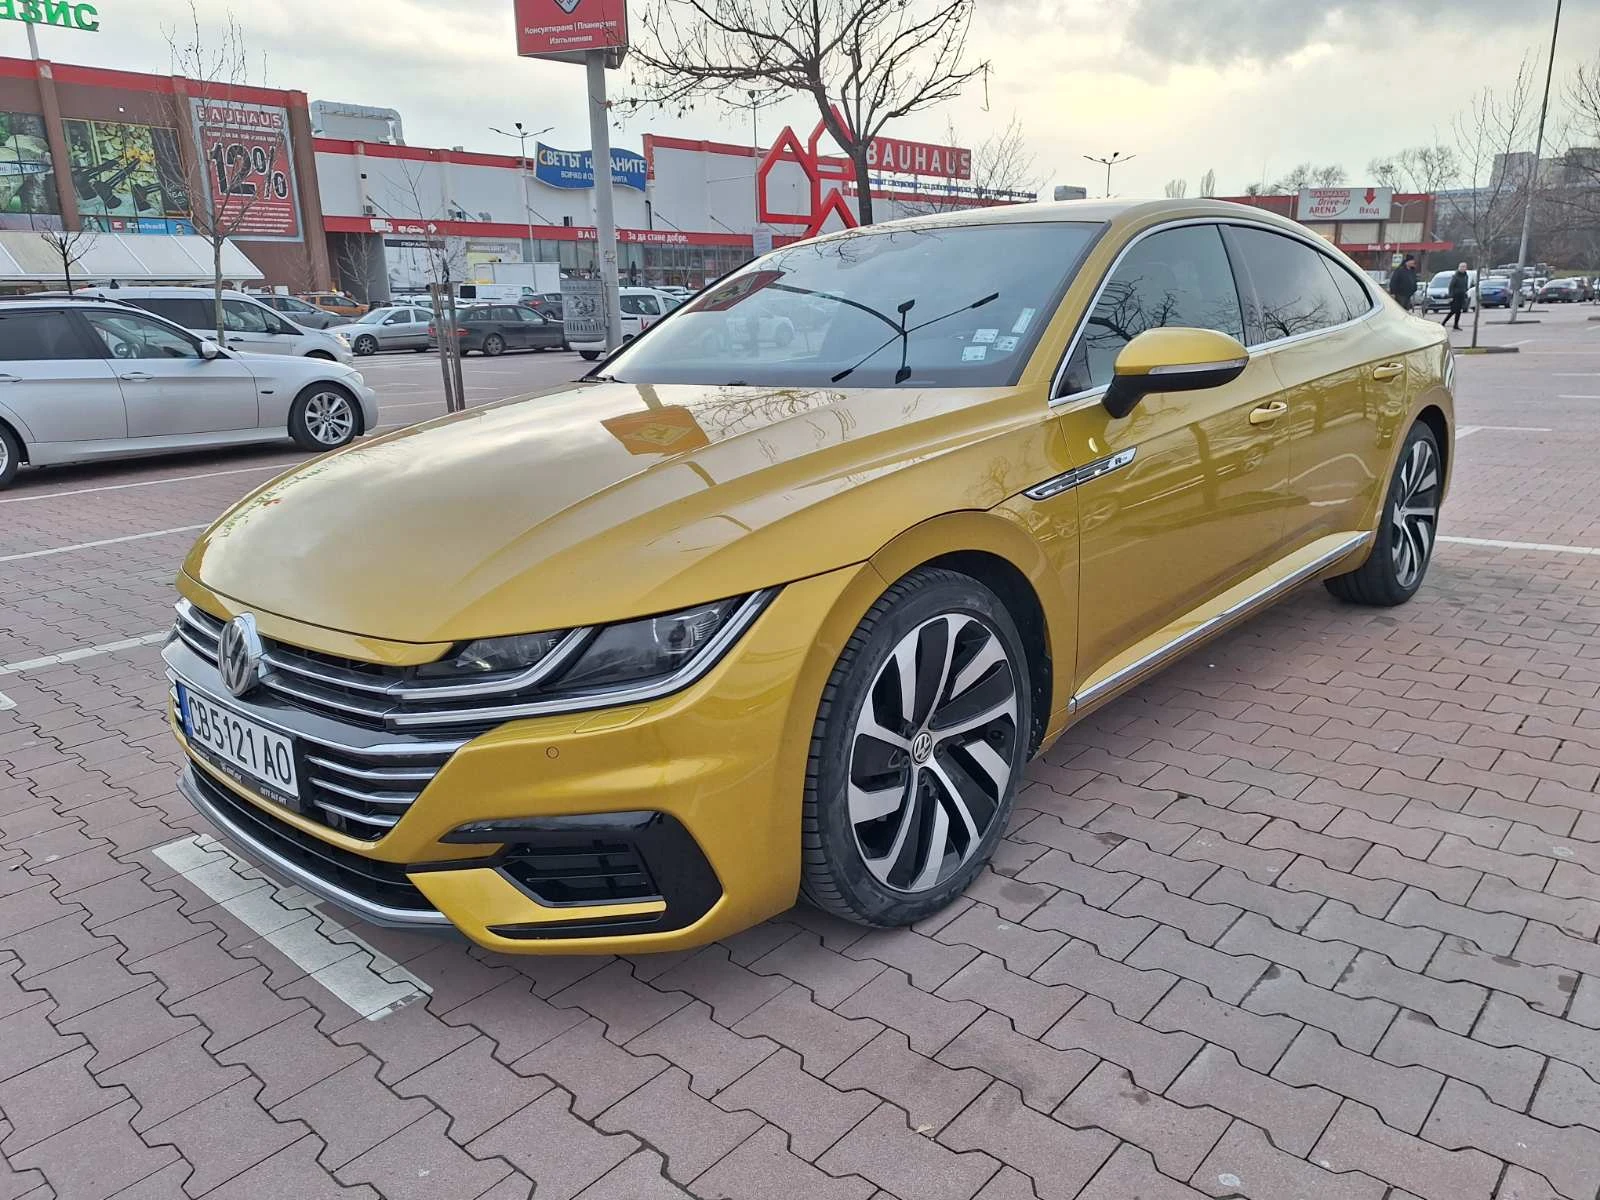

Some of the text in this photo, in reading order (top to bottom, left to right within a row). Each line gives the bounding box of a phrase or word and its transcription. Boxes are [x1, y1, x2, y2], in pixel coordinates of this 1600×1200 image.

[198, 107, 283, 126] BAUHAUS
[539, 149, 581, 169] СВЕТЪТ
[610, 158, 645, 173] АНИТЕ
[865, 140, 970, 175] BAUHAUS
[207, 142, 289, 200] 12%
[1309, 206, 1337, 214] ARENA
[1359, 207, 1379, 216] Вход
[577, 230, 620, 240] BAUS
[627, 231, 637, 240] За
[637, 233, 646, 241] да
[647, 233, 666, 241] стане
